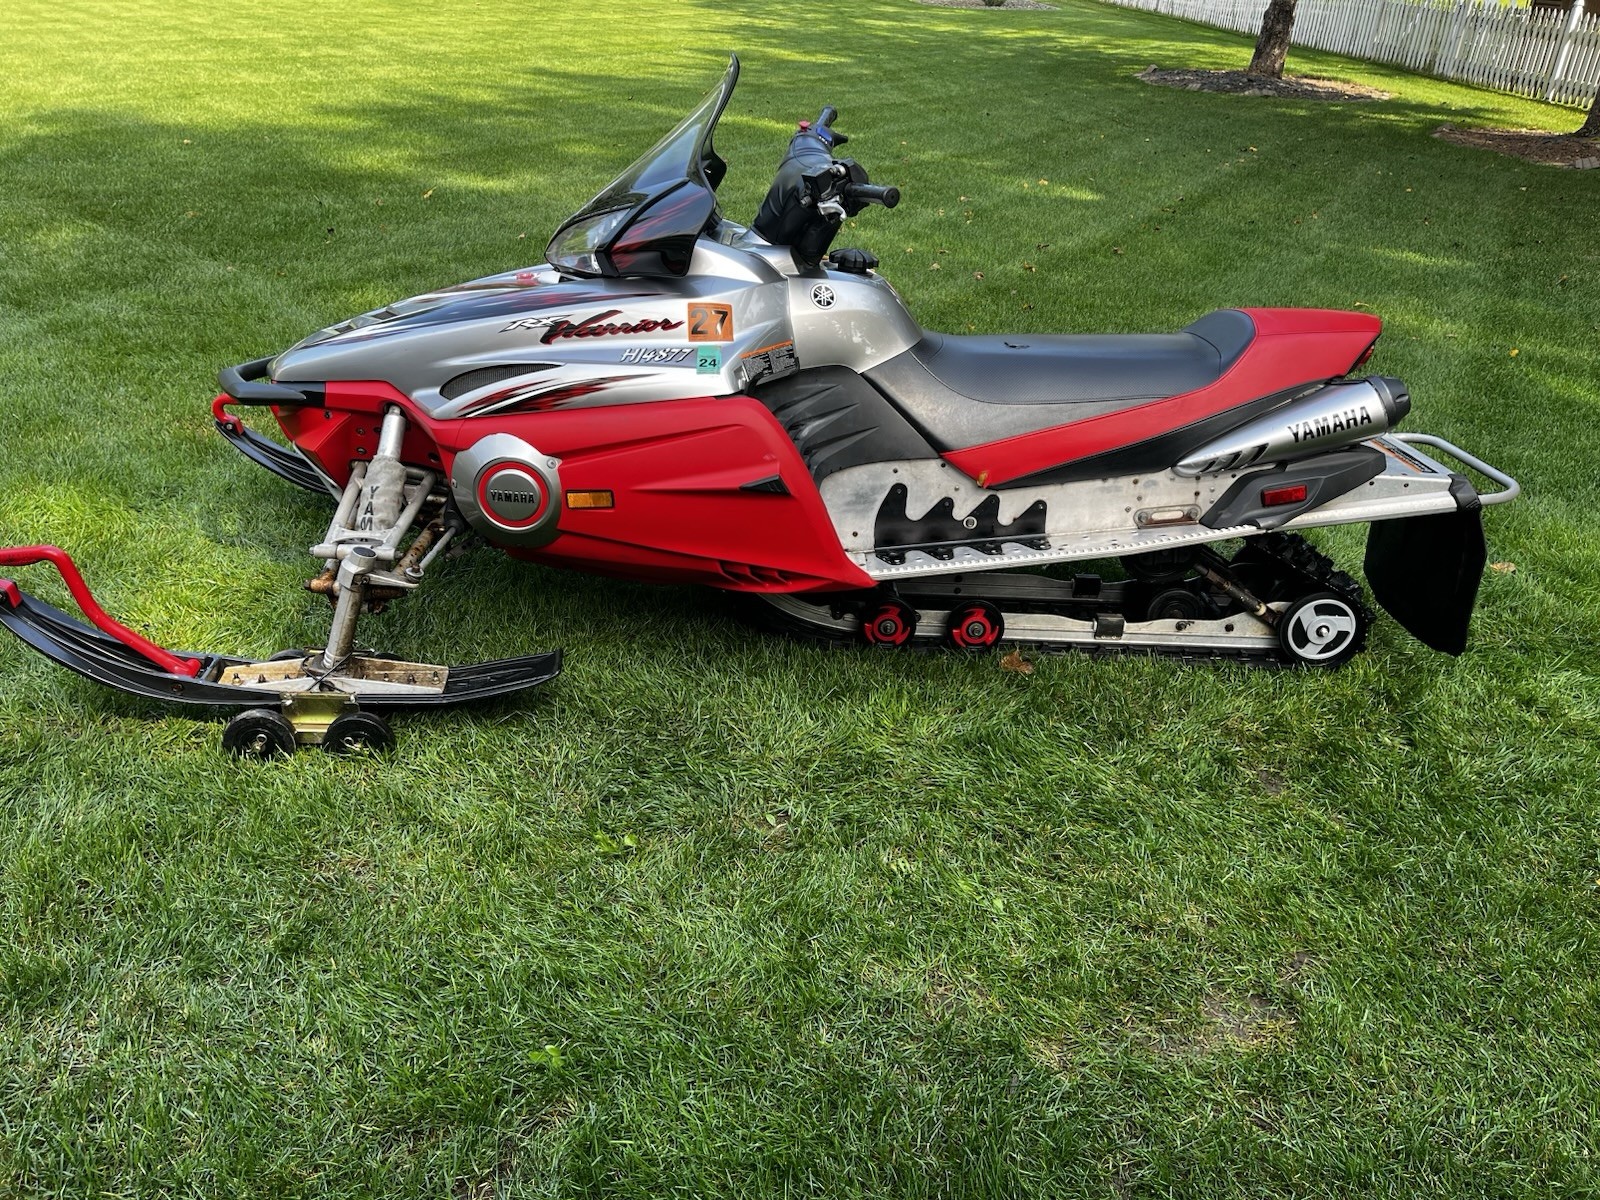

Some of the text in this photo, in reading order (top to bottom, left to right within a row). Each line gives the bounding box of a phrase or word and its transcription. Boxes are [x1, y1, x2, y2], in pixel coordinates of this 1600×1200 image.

[500, 309, 685, 345] RX Warrior
[690, 308, 728, 335] 27
[620, 348, 694, 364] HJ4877
[699, 358, 717, 368] 24
[1287, 406, 1372, 443] YAMAHA
[490, 489, 535, 504] YAMAHA
